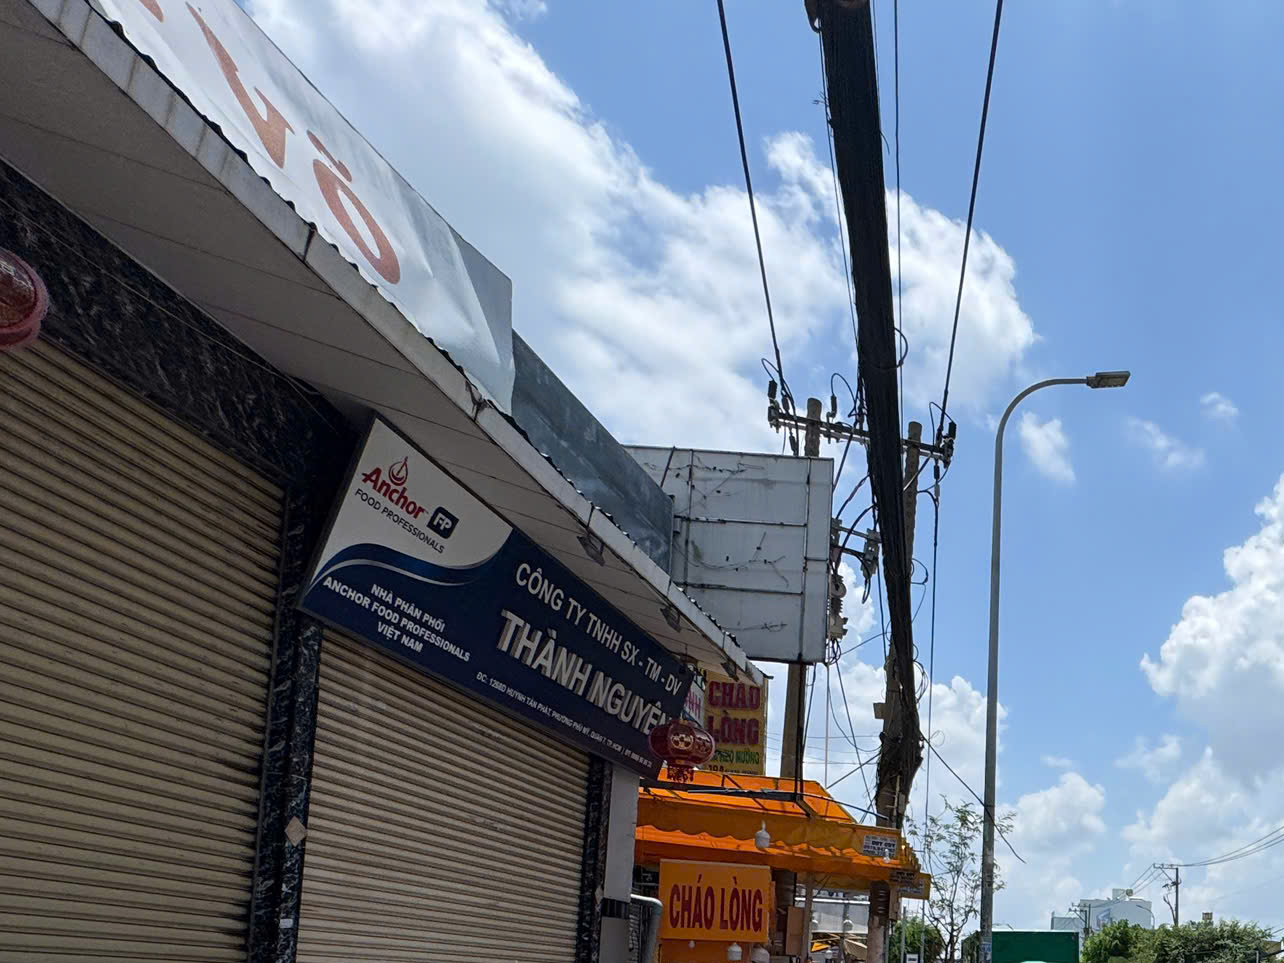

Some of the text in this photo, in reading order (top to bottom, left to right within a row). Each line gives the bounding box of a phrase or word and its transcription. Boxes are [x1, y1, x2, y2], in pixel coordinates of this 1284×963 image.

[362, 467, 426, 519] Anchor
[355, 488, 445, 554] FOOD PROFESSIONALS
[433, 512, 453, 531] FP
[322, 576, 471, 663] ANCHOR FOOD PROFESSIONALS
[371, 583, 446, 634] NHÀ PHÂN PHỐI
[516, 562, 564, 611] CÔNG
[566, 597, 588, 626] TY
[586, 612, 623, 654] TNHH
[621, 641, 640, 667] SX
[645, 656, 663, 683] TM
[664, 673, 682, 697] DV
[377, 621, 423, 653] VIỆT NAM
[497, 608, 594, 697] THÀNH
[706, 709, 760, 745] LÒNG
[669, 873, 763, 932] CHÁO LÒNG
